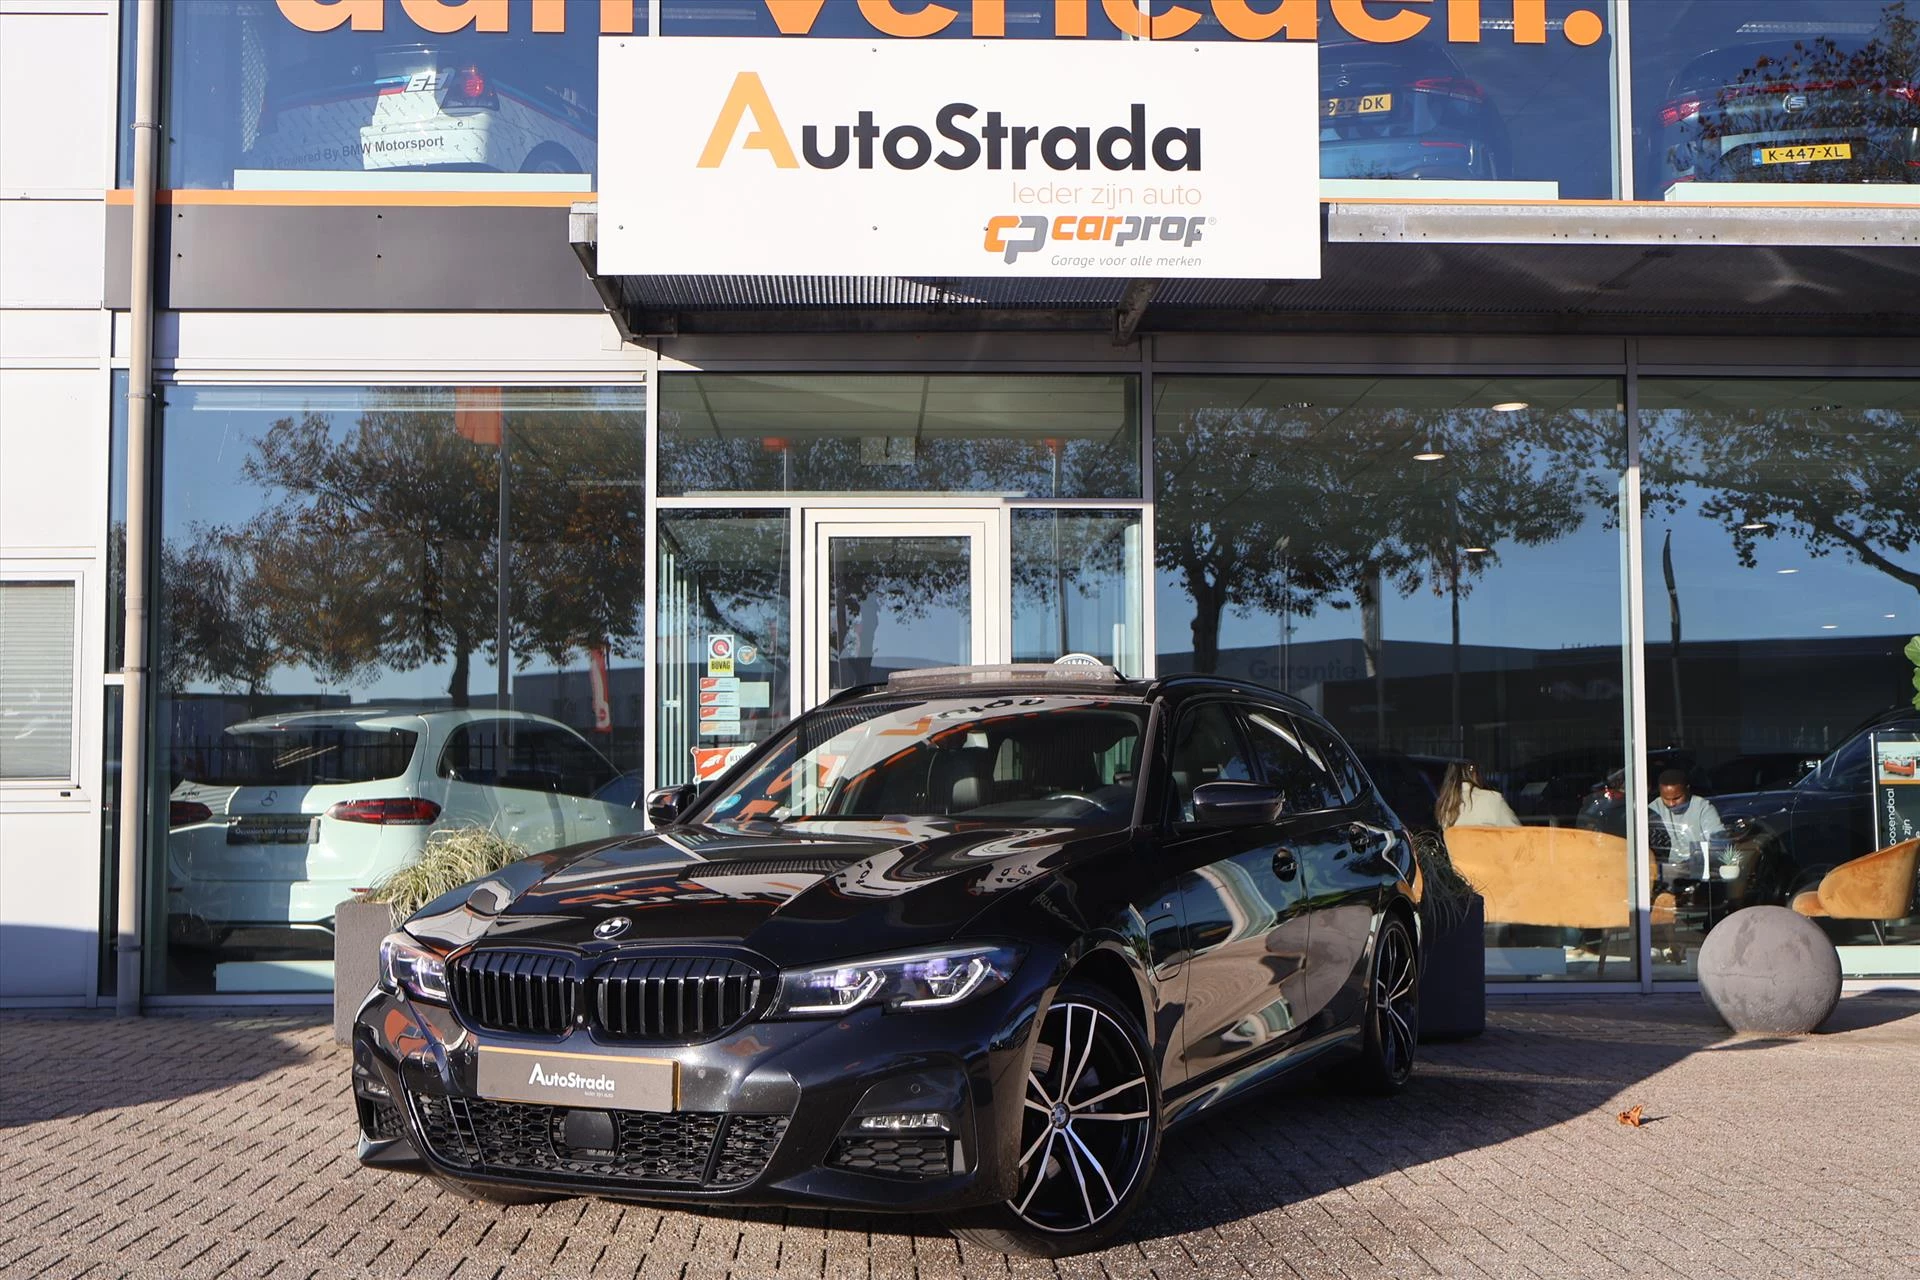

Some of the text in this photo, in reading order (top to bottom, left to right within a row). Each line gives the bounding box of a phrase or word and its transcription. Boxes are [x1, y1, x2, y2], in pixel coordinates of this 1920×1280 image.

[1321, 97, 1384, 112] -932-DK
[696, 71, 1202, 172] AutoStrada
[323, 148, 339, 162] By
[342, 142, 372, 158] BMW
[375, 135, 445, 153] Motorsport
[1768, 147, 1843, 160] K-447-XL
[1013, 182, 1202, 211] Ieder zijn auto
[1051, 255, 1202, 269] Garage voor alle merken
[711, 660, 731, 670] BOVAG
[1248, 659, 1357, 680] Garantie
[1886, 788, 1897, 846] oosendaal
[1902, 819, 1912, 835] zijn
[528, 1063, 616, 1091] AutoStrada
